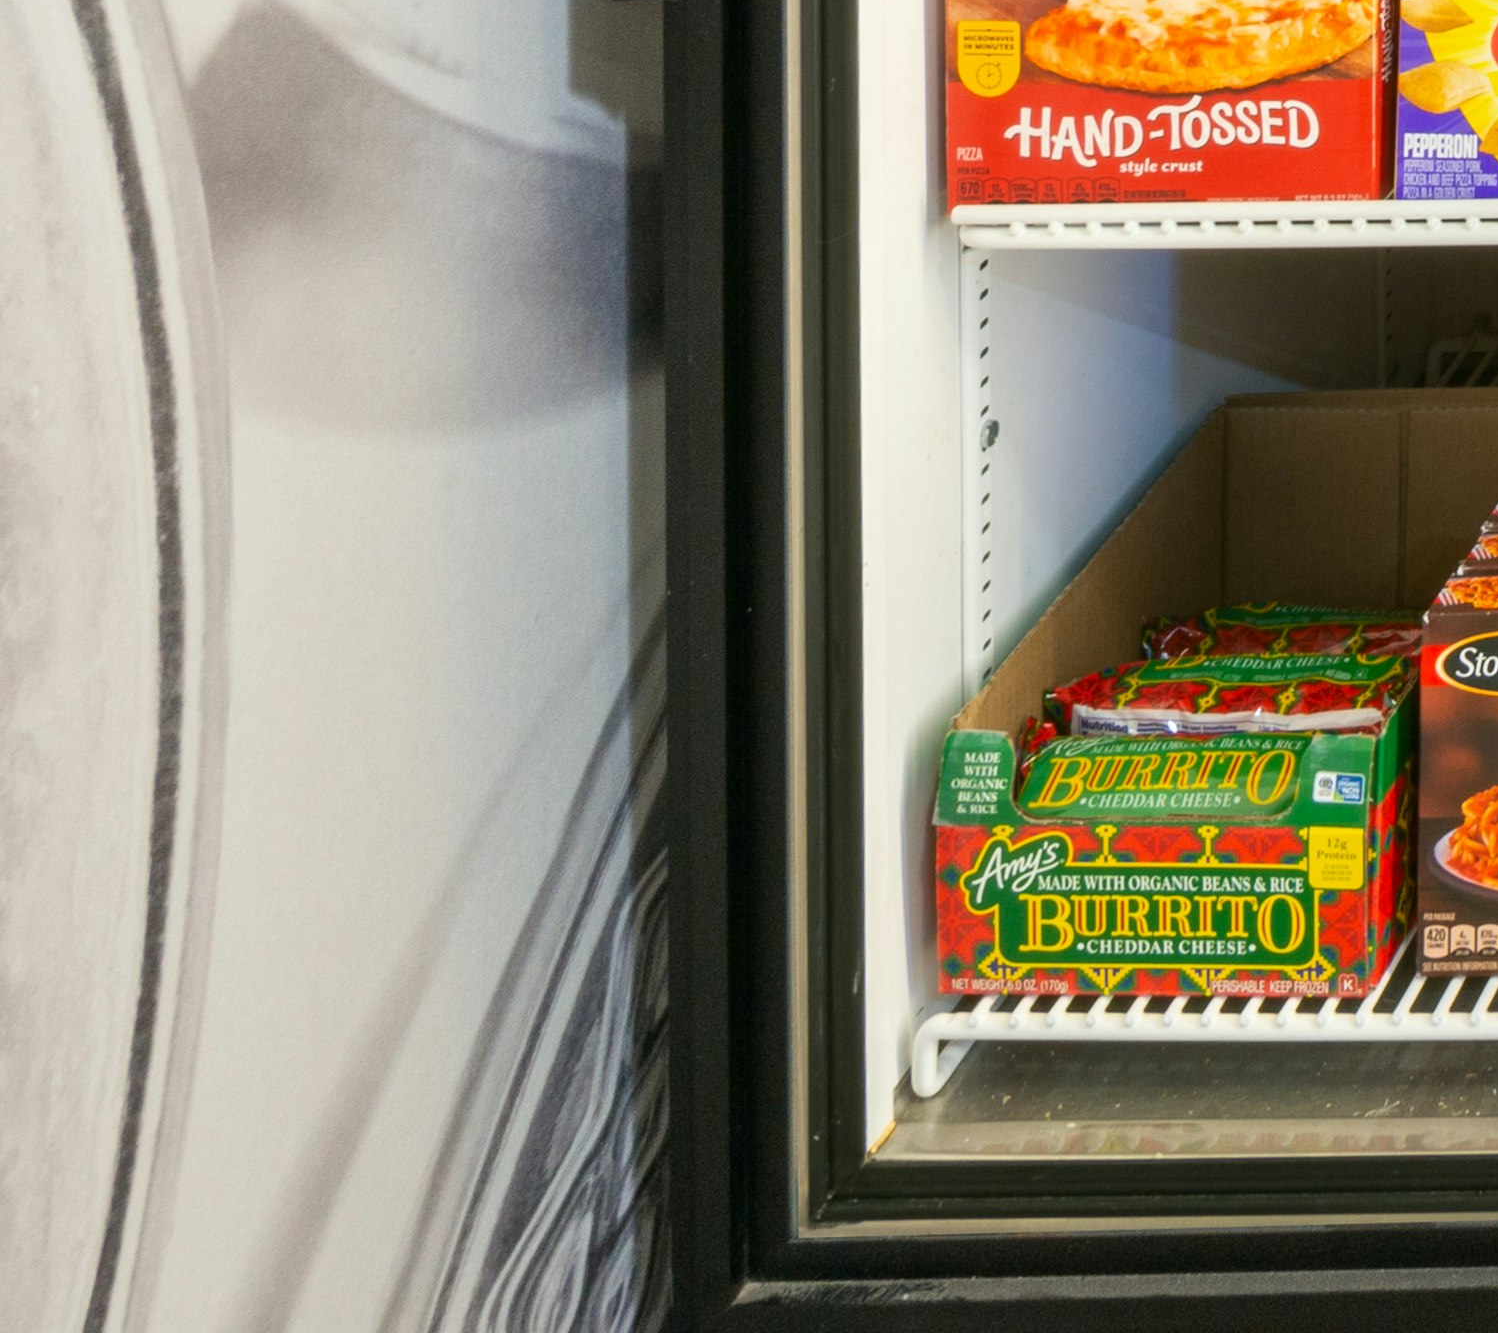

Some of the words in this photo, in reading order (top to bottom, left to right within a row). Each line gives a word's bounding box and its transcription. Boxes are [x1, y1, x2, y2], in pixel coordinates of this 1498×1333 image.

[963, 34, 1014, 42] MICROWAVES
[963, 43, 974, 51] IN
[977, 43, 1014, 51] MINUTES
[1004, 96, 1320, 168] HAND-TOSSED
[1403, 133, 1478, 159] PEPPERONI
[1119, 158, 1157, 176] style
[1161, 159, 1202, 173] crust
[970, 841, 1064, 904] Amy's
[1038, 876, 1080, 891] MADE
[1084, 876, 1124, 891] WITH
[1128, 876, 1198, 892] ORGANIC
[1201, 876, 1251, 892] BEANS
[1254, 877, 1266, 892] &
[1269, 877, 1304, 893] RICE
[1019, 894, 1306, 954] BURRITO
[1087, 939, 1174, 955] CHEDDAR
[1179, 939, 1248, 956] CHEESE
[1212, 979, 1265, 993] PERISHABLE
[1269, 980, 1292, 993] KEEP
[1295, 981, 1328, 993] FROZEN
